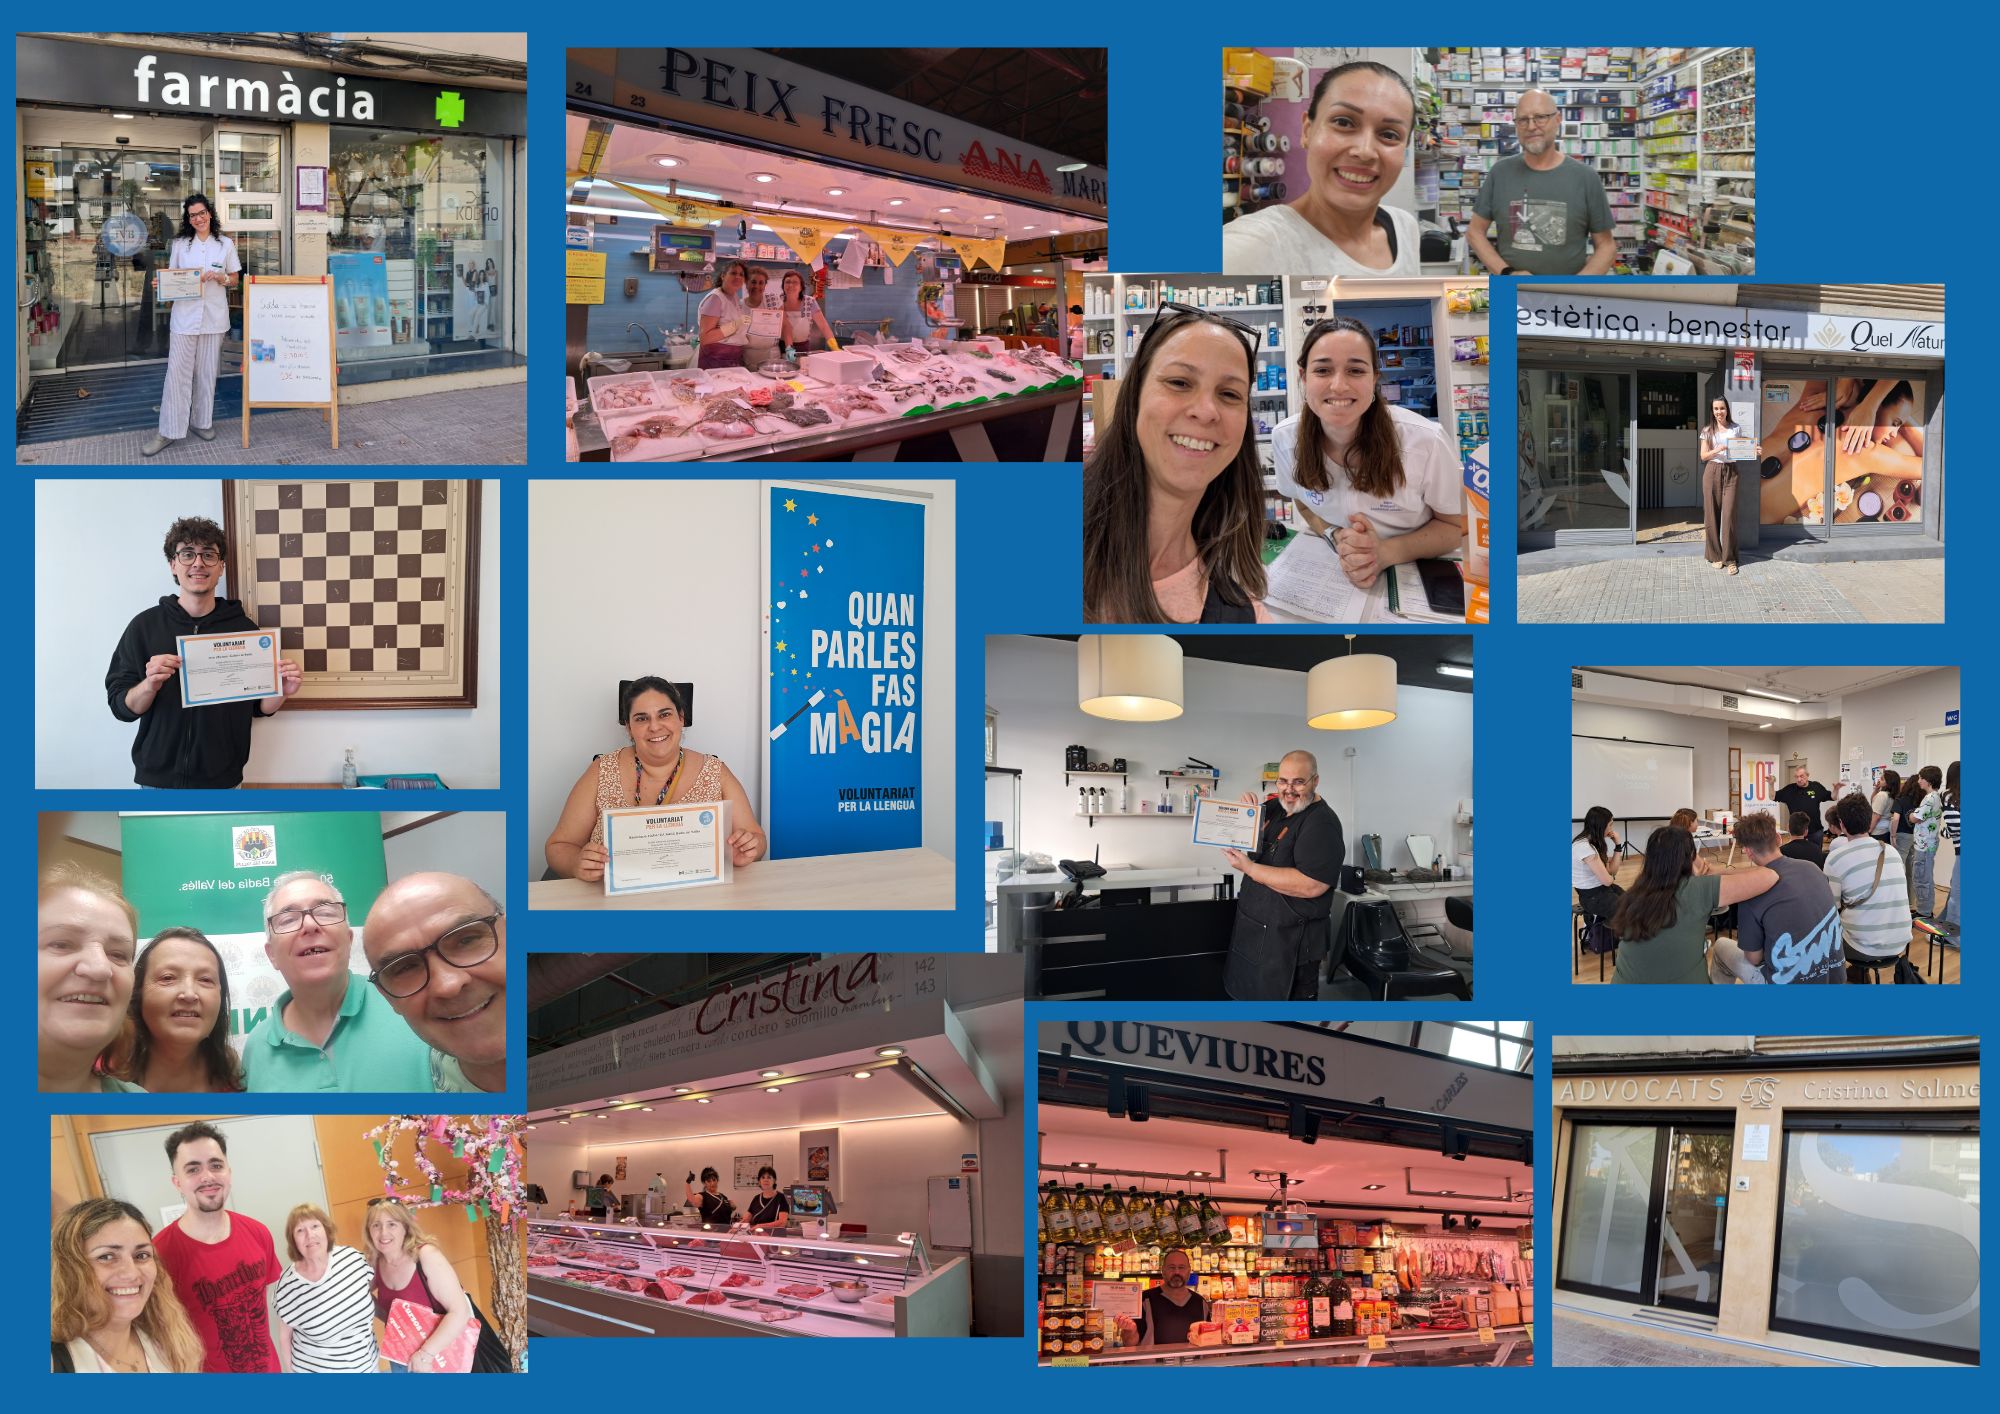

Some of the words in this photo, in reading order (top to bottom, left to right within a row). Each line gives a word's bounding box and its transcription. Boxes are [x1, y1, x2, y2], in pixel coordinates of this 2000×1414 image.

[134, 55, 374, 120] farmàcia
[574, 81, 593, 98] 24
[630, 94, 646, 108] 23
[657, 47, 800, 127] PEIX
[821, 95, 943, 164] FRESC
[960, 139, 1052, 194] ANA
[1516, 305, 1640, 332] estètica
[1667, 310, 1791, 341] benestar
[1850, 320, 1893, 352] Quel
[848, 591, 915, 630] QUAN
[811, 629, 916, 670] PARLES
[871, 673, 916, 707] FAS
[809, 688, 916, 755] MÀGIA
[838, 786, 916, 801] VOLUNTARIAT
[838, 802, 857, 813] PER
[859, 801, 872, 812] LA
[873, 800, 916, 811] LLENGUA
[645, 815, 684, 825] VOLUNTARIAT
[915, 956, 935, 974] 142
[695, 953, 878, 1035] Cristina
[915, 978, 936, 996] 143
[730, 1022, 778, 1042] cordero
[784, 1004, 838, 1030] solomillo
[1067, 1021, 1326, 1087] QUEVIURES
[1559, 1077, 1725, 1101] ADVOCATS
[1804, 1079, 1889, 1100] Cristina
[402, 1302, 422, 1332] Cursos
